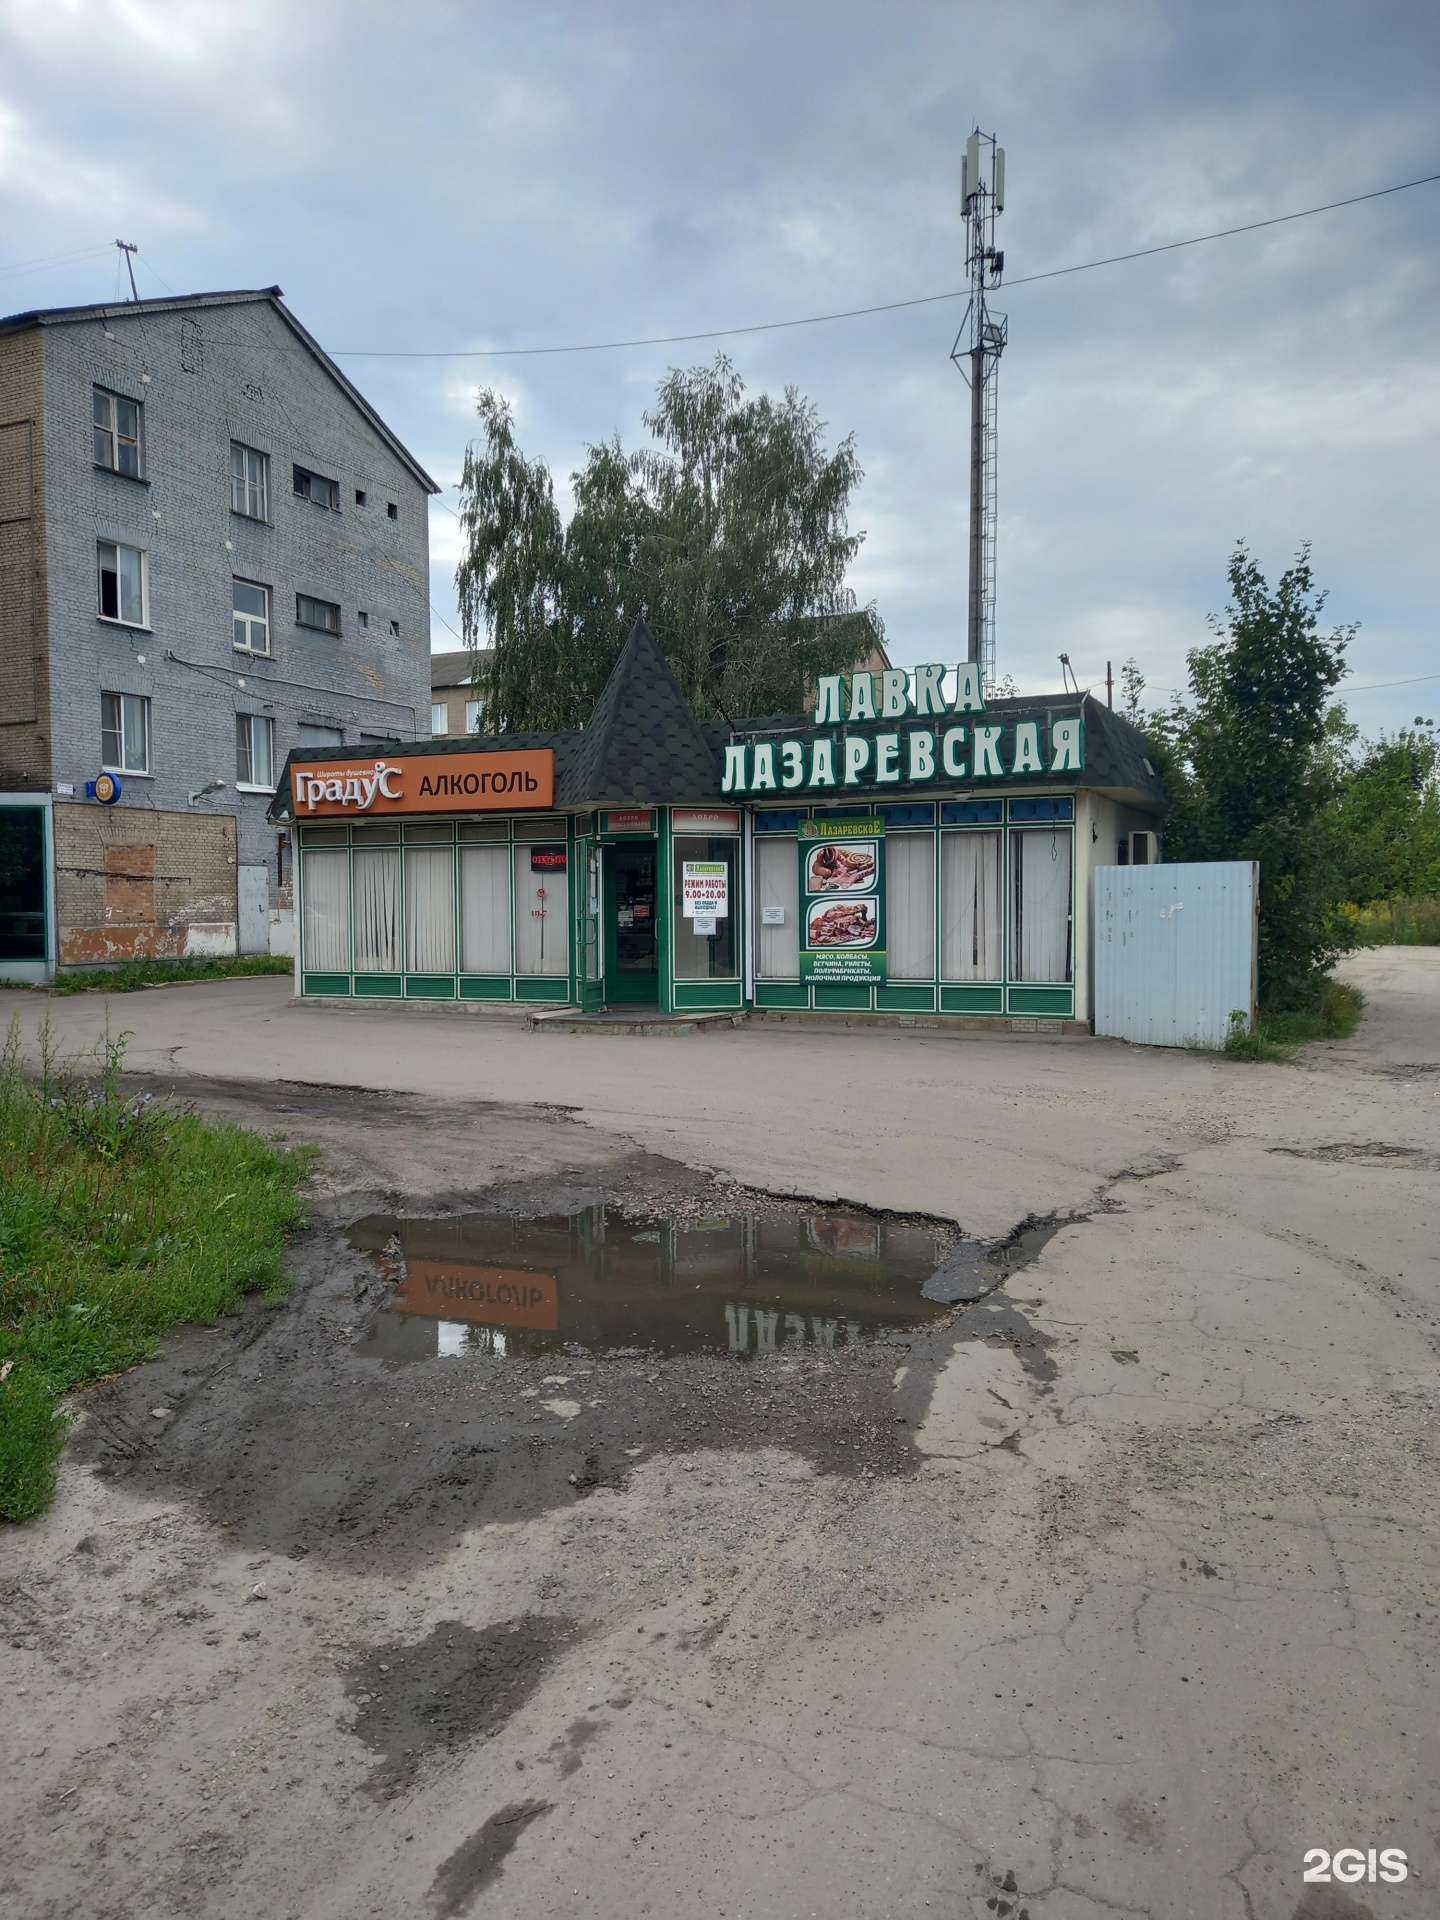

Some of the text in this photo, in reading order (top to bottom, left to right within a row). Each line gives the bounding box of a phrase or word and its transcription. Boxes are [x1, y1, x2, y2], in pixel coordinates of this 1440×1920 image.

[815, 661, 987, 724] ЛАВКА
[721, 717, 1085, 795] ЛАЗАРЕВСКАЯ
[419, 771, 538, 796] АЛКОГОЛЬ
[684, 879, 727, 889] РЕЖИМ РАБОТЫ
